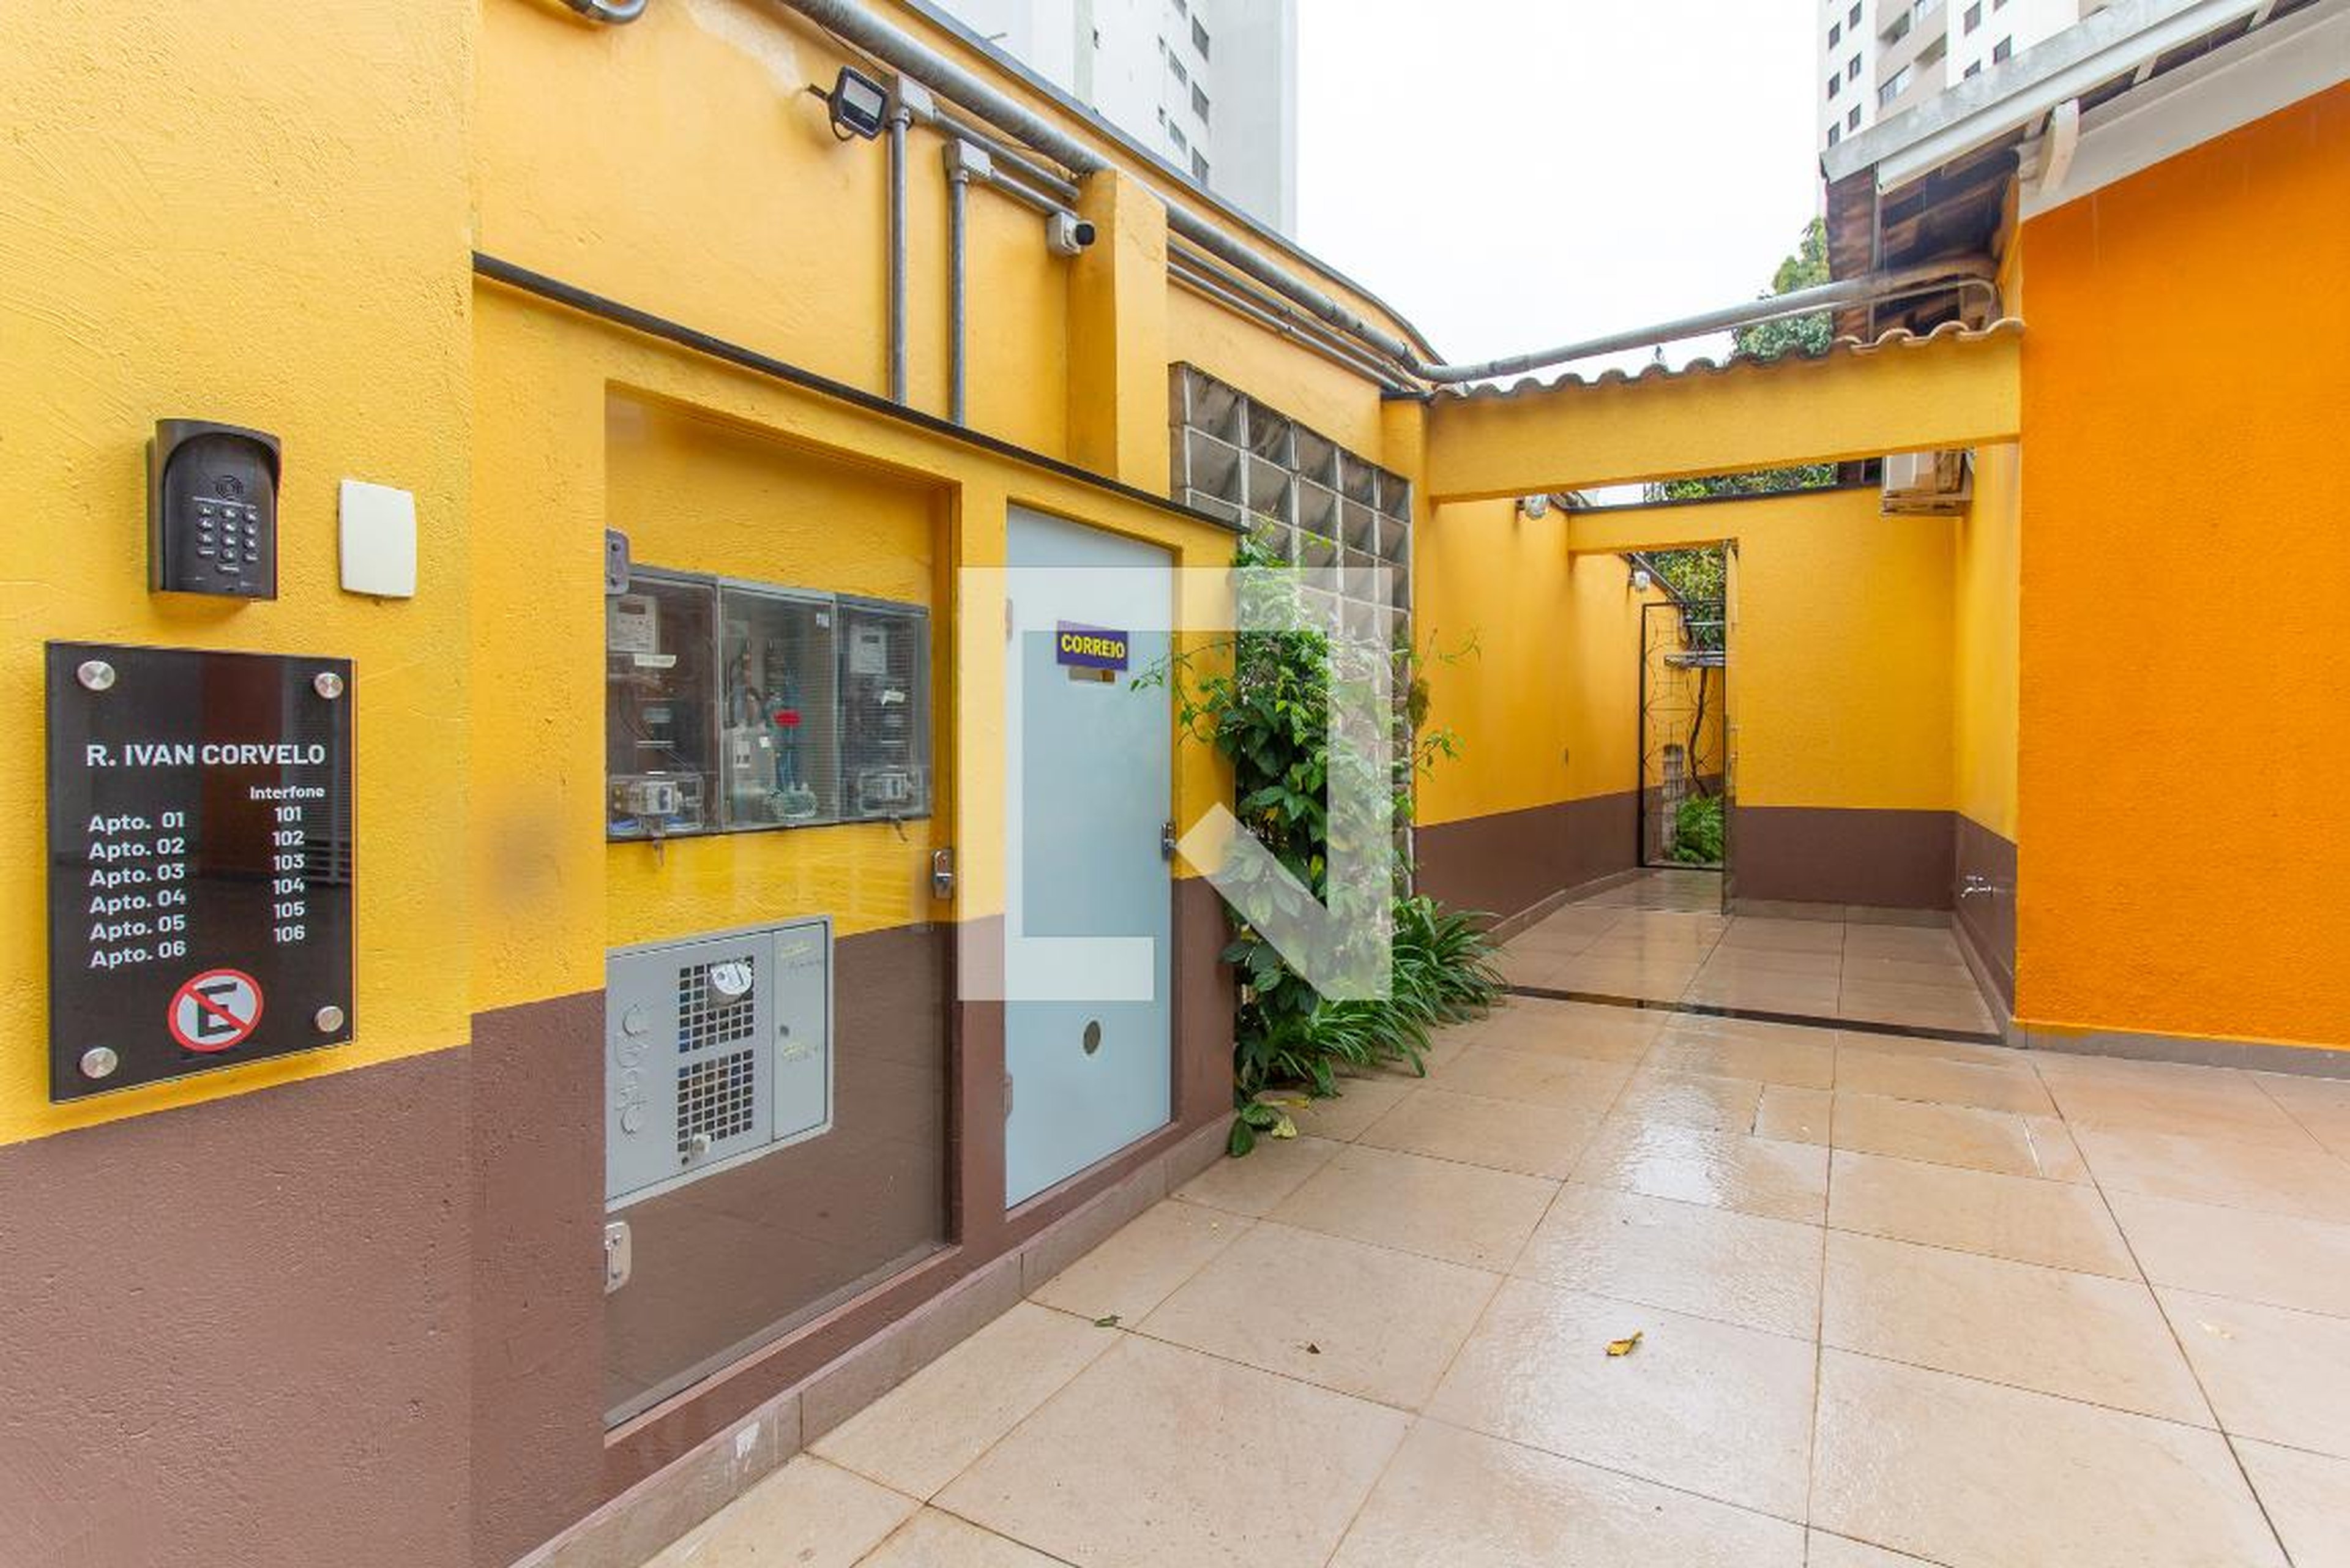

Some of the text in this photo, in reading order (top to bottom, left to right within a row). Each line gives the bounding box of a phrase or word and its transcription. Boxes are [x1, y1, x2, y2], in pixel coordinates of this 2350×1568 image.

[1061, 633, 1126, 659] CORREIO
[86, 743, 326, 767] R. IVAN CORVELO
[249, 785, 326, 801] Interfone
[88, 806, 302, 835] Apto. 01 101
[88, 830, 305, 861] Apto. 02 102
[88, 853, 305, 888] Apto. 03 103
[89, 877, 305, 916] Apto. 04 104
[89, 900, 305, 942] Apto. 05 105
[89, 924, 306, 969] Apto. 06 106
